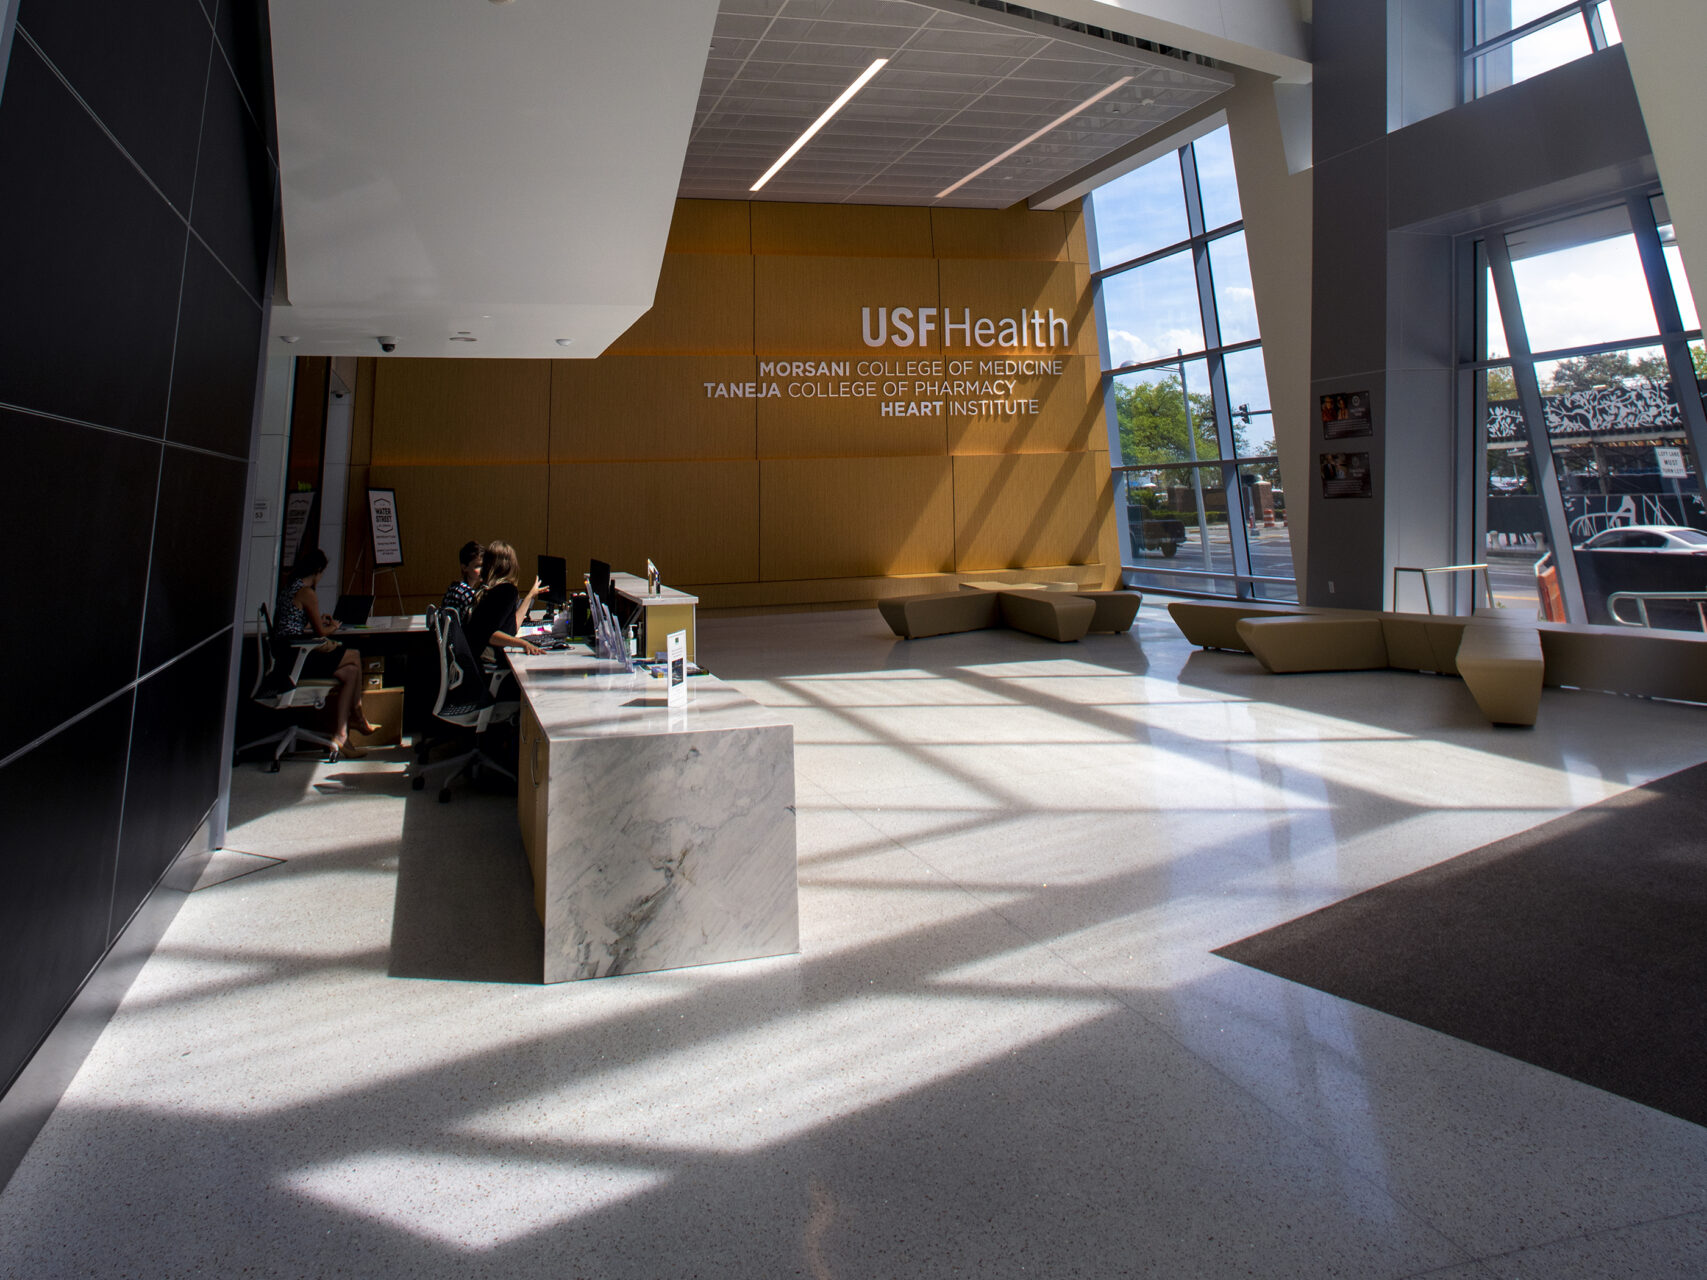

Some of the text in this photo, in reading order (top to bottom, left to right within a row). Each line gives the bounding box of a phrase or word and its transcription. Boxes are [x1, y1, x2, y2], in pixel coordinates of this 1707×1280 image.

[861, 306, 1069, 348] USF Health
[759, 360, 1064, 377] MORSANI COLLEGE OF MEDICINE
[703, 380, 1017, 399] TANEJA COLLEGE OF PHARMACY
[881, 400, 1040, 417] HEART INSTITUTE
